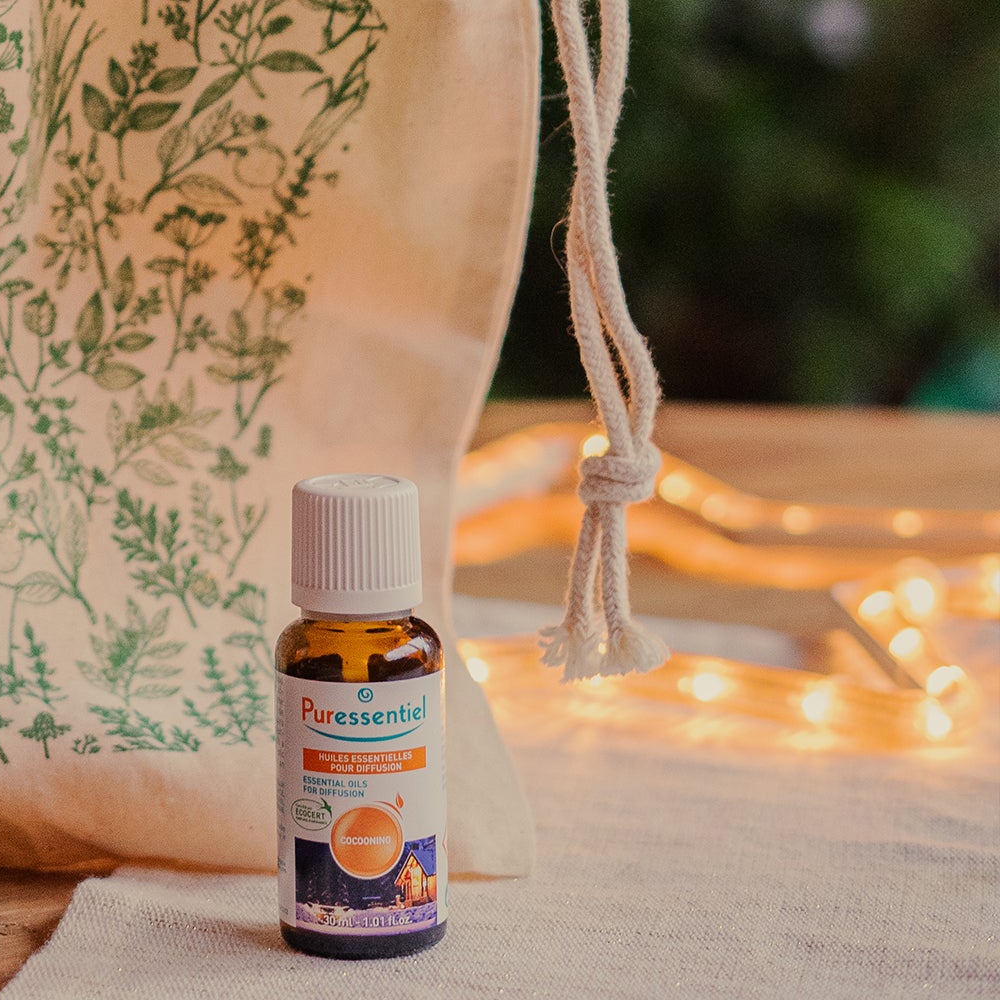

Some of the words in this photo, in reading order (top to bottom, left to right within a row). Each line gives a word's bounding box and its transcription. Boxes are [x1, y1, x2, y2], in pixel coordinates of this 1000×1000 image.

[301, 695, 426, 725] Puressentiel
[319, 753, 349, 762] HUILES
[351, 751, 413, 762] ESSENTIELLES
[330, 763, 354, 772] POUR
[356, 762, 402, 773] DIFFUSION
[303, 776, 346, 788] ESSENTIAL
[348, 780, 368, 788] OILS
[303, 785, 318, 795] FOR
[319, 787, 364, 797] DIFFUSION
[296, 808, 325, 820] ECOCERT
[323, 915, 336, 926] 30
[338, 916, 353, 927] ml
[362, 917, 385, 927] 1.01
